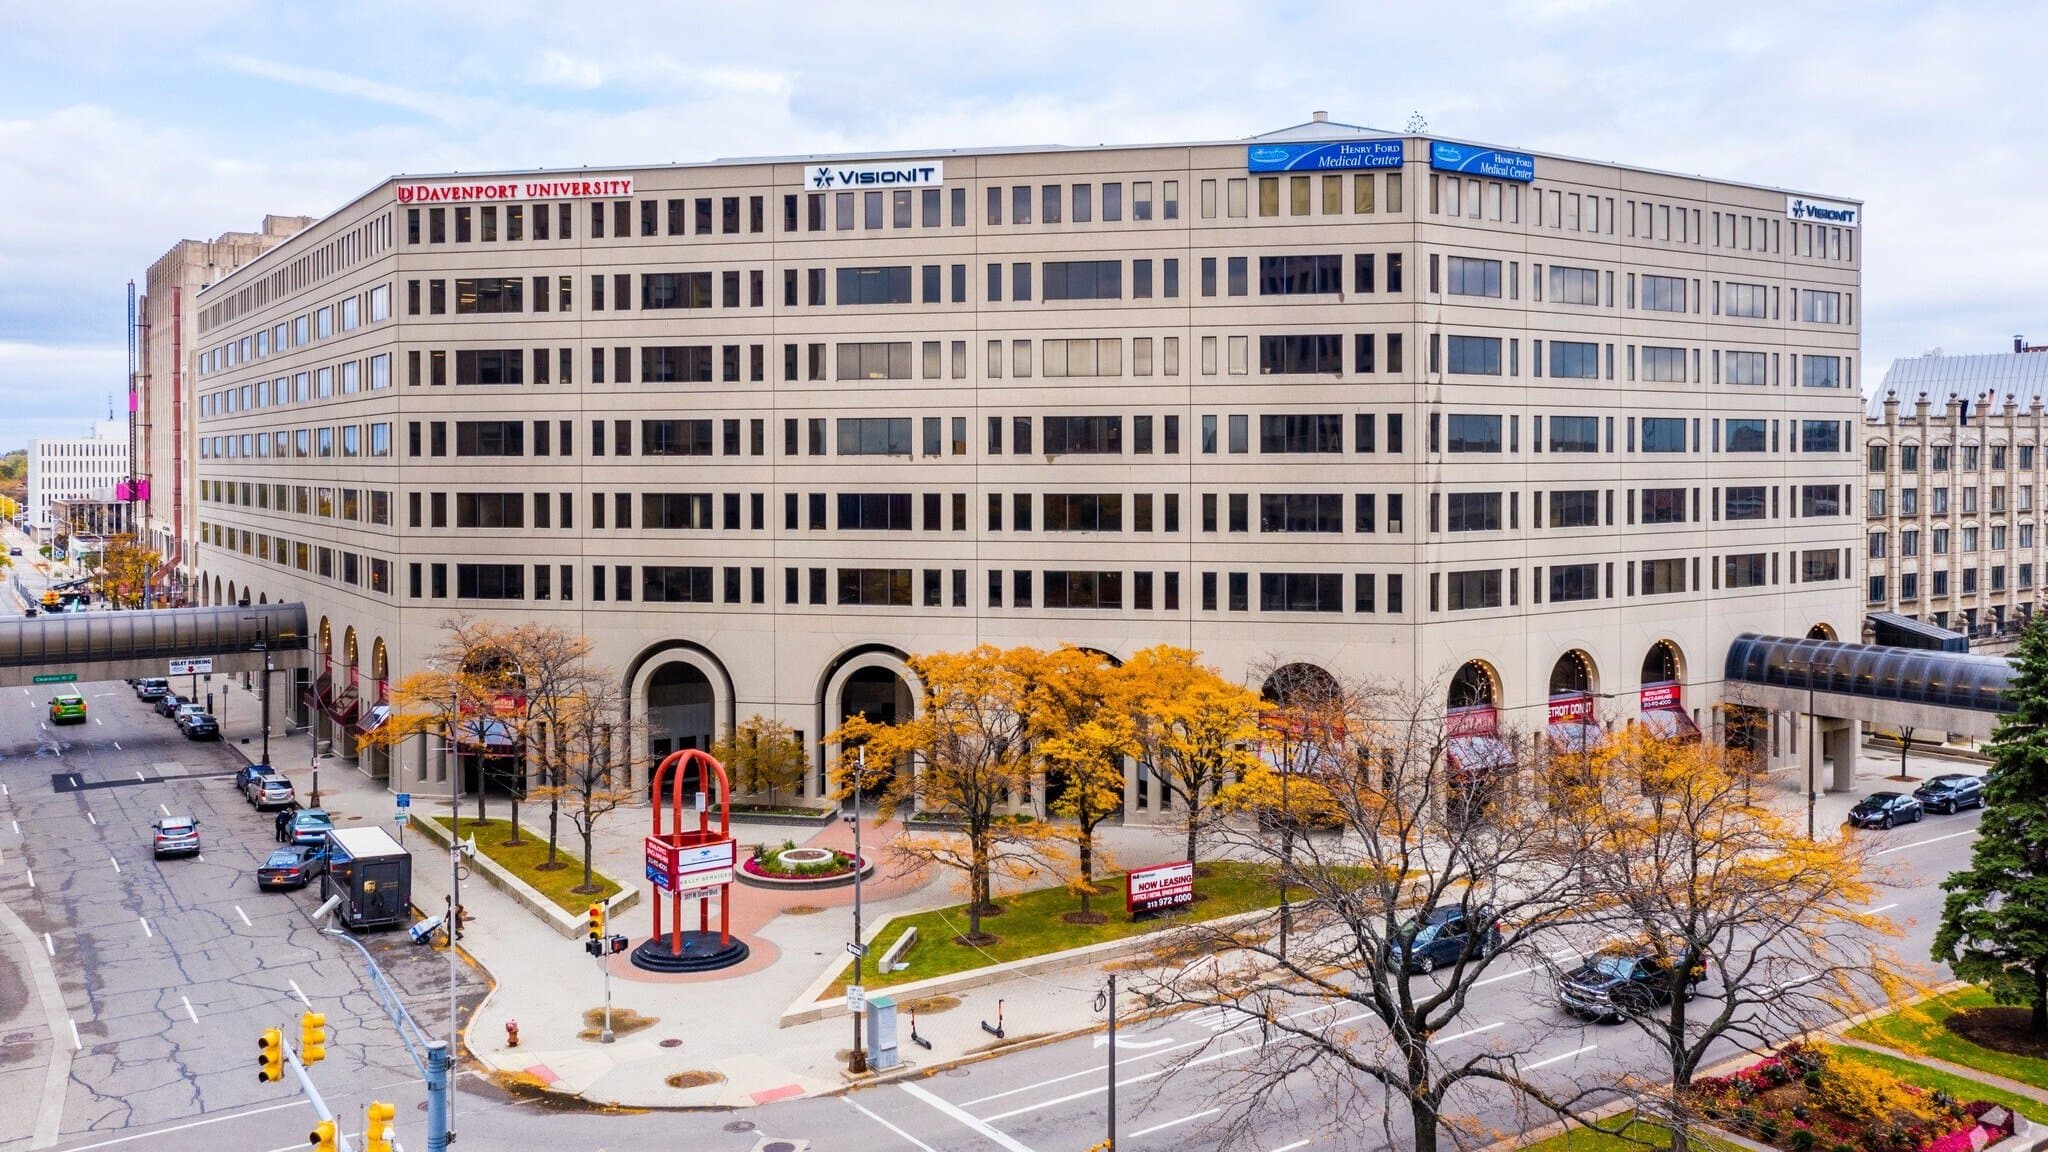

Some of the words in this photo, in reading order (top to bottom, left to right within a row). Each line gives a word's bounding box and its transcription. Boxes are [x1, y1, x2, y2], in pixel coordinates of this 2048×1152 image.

[1340, 145, 1372, 154] HENRY
[1374, 143, 1400, 153] FORD
[1318, 156, 1362, 168] Medical
[1364, 154, 1401, 166] Center
[1494, 153, 1515, 164] HENRY
[1515, 157, 1533, 168] FORD
[1480, 162, 1509, 175] Medical
[1509, 166, 1533, 179] Center
[416, 184, 518, 201] DAVENPORT
[526, 180, 631, 197] UNIVERSITY
[1548, 704, 1570, 718] ETROIT
[1139, 881, 1158, 891] NOW
[1160, 875, 1192, 887] LEASING
[1147, 901, 1158, 909] 313
[1159, 896, 1173, 905] 972
[1174, 894, 1192, 903] 4000
